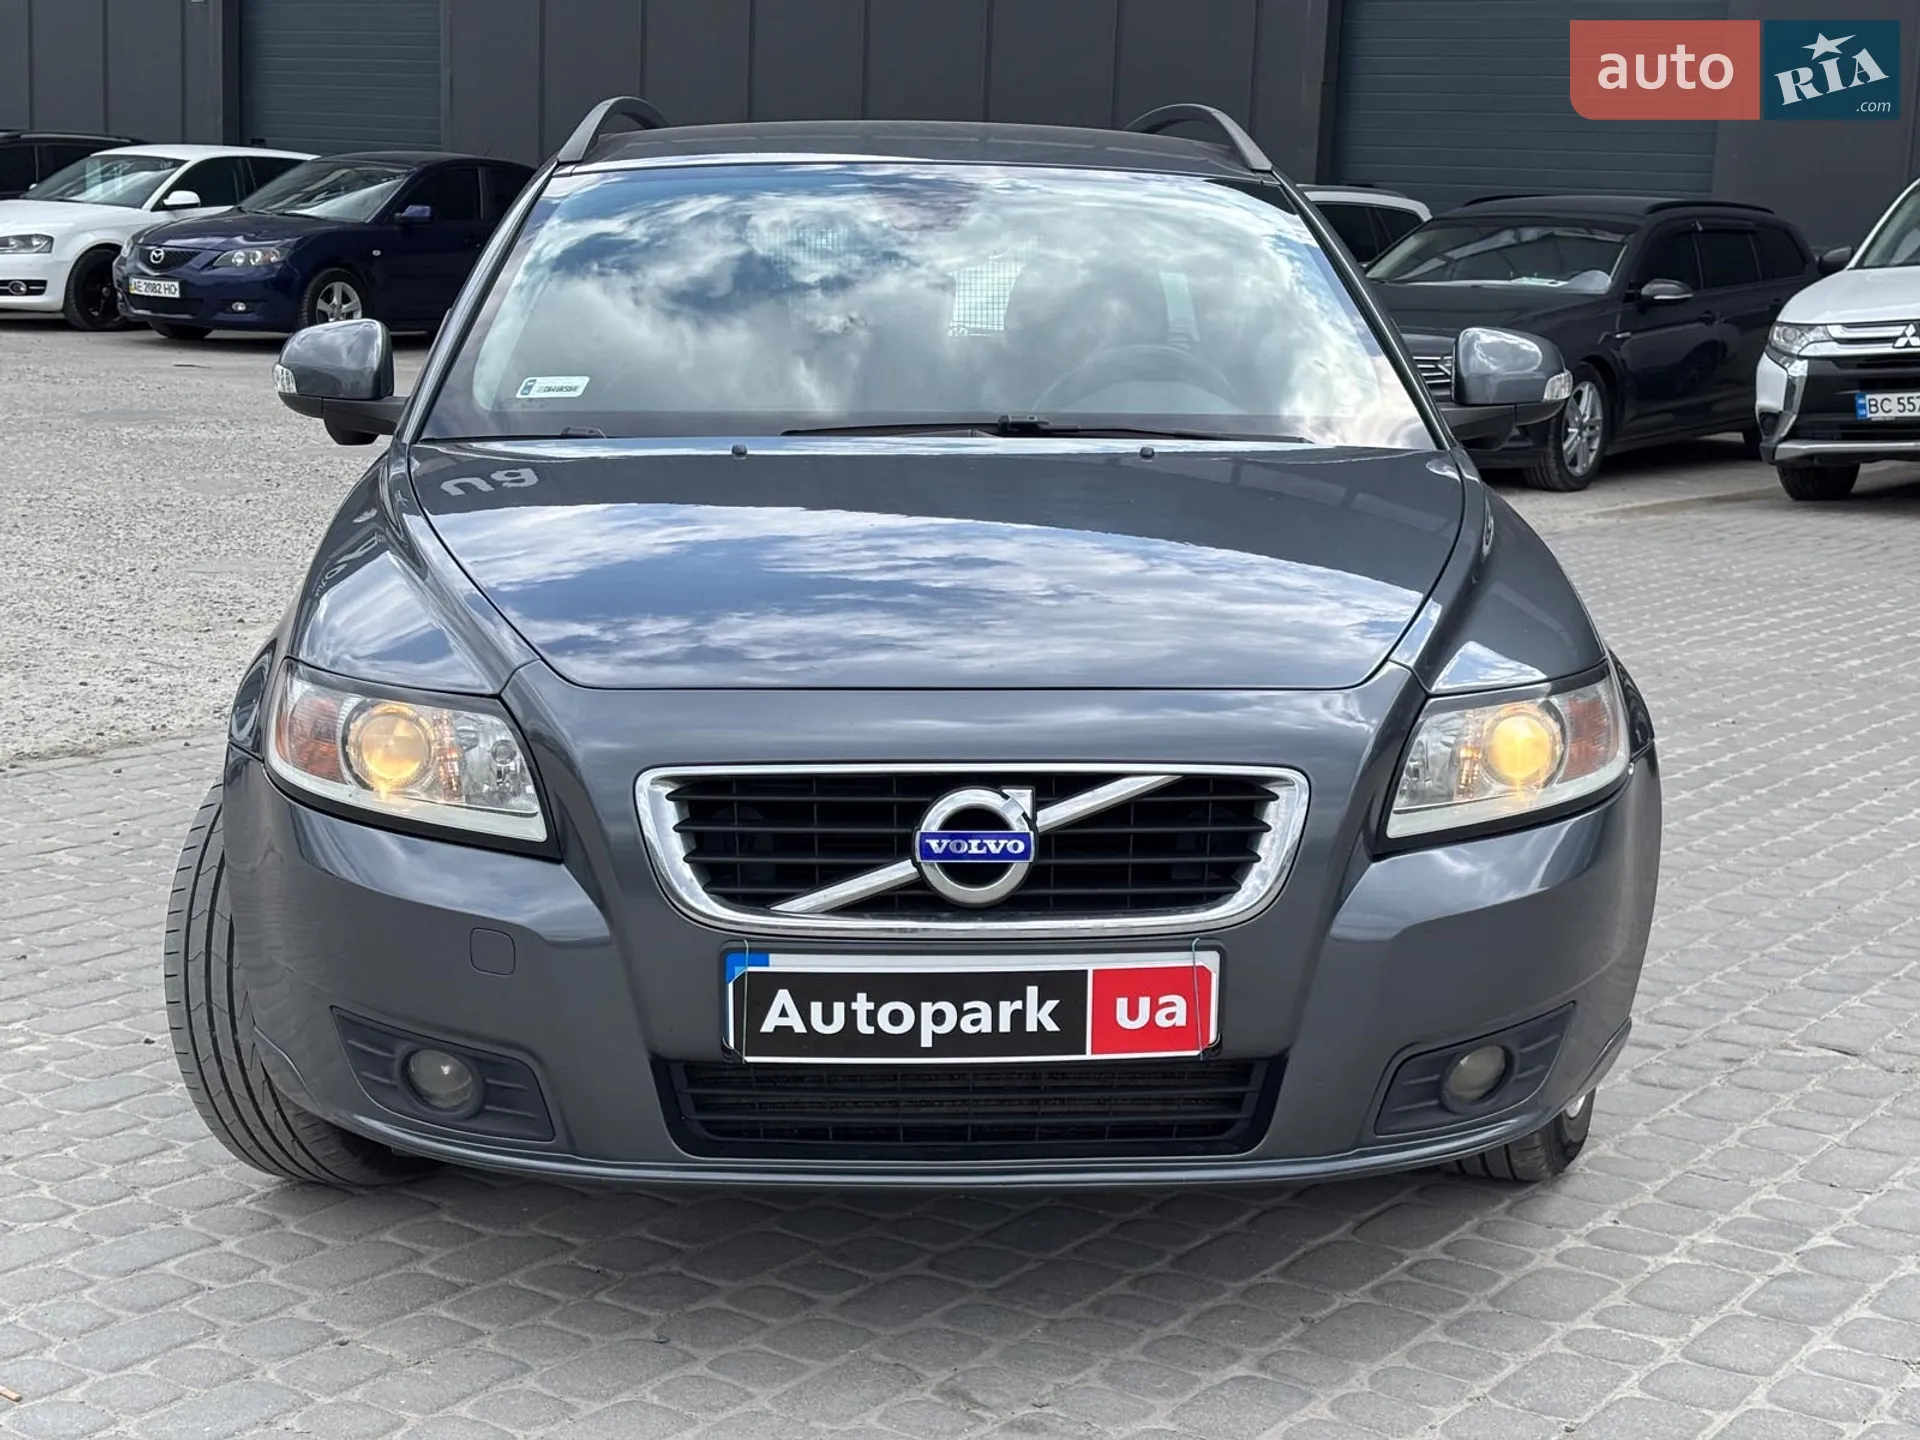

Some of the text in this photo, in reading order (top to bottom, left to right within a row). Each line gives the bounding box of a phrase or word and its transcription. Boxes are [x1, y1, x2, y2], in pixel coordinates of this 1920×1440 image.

[1868, 397, 1892, 414] BC
[925, 839, 1025, 854] VOLVO
[760, 985, 1188, 1048] Autopark ua
